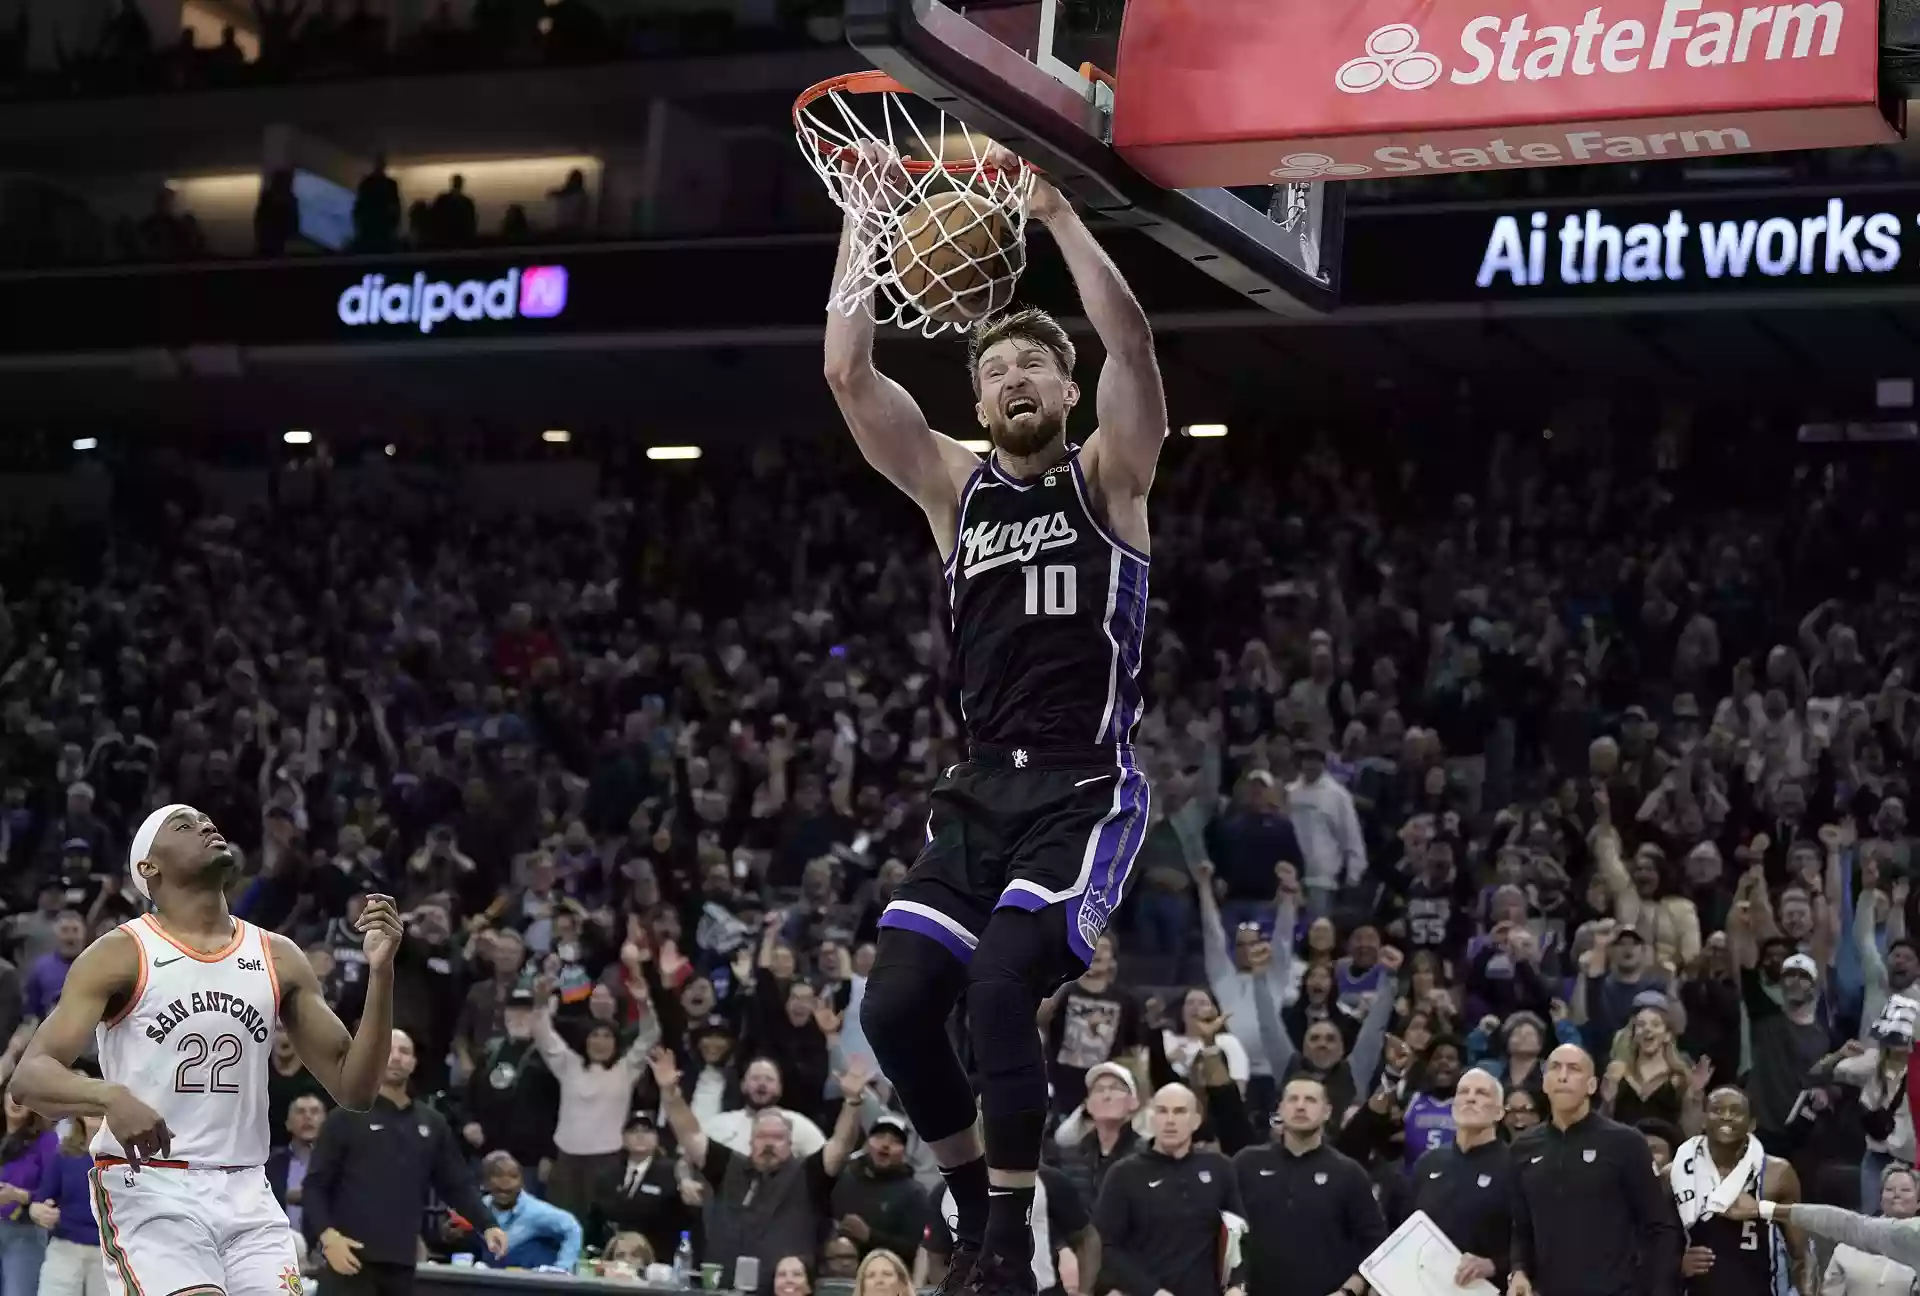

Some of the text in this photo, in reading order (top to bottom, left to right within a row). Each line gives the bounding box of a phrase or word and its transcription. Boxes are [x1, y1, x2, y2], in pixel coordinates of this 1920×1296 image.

[1374, 127, 1751, 172] State Farm
[1475, 211, 1548, 288] Ai
[1559, 209, 1689, 284] that
[1699, 197, 1902, 279] works
[337, 266, 520, 334] dialpad
[962, 511, 1078, 580] Kings
[1021, 565, 1077, 615] 10
[236, 957, 266, 972] Self.
[145, 990, 269, 1044] SAN ANTONIO
[174, 1032, 243, 1094] 22
[1425, 1129, 1441, 1150] 5
[1739, 1220, 1759, 1251] 5
